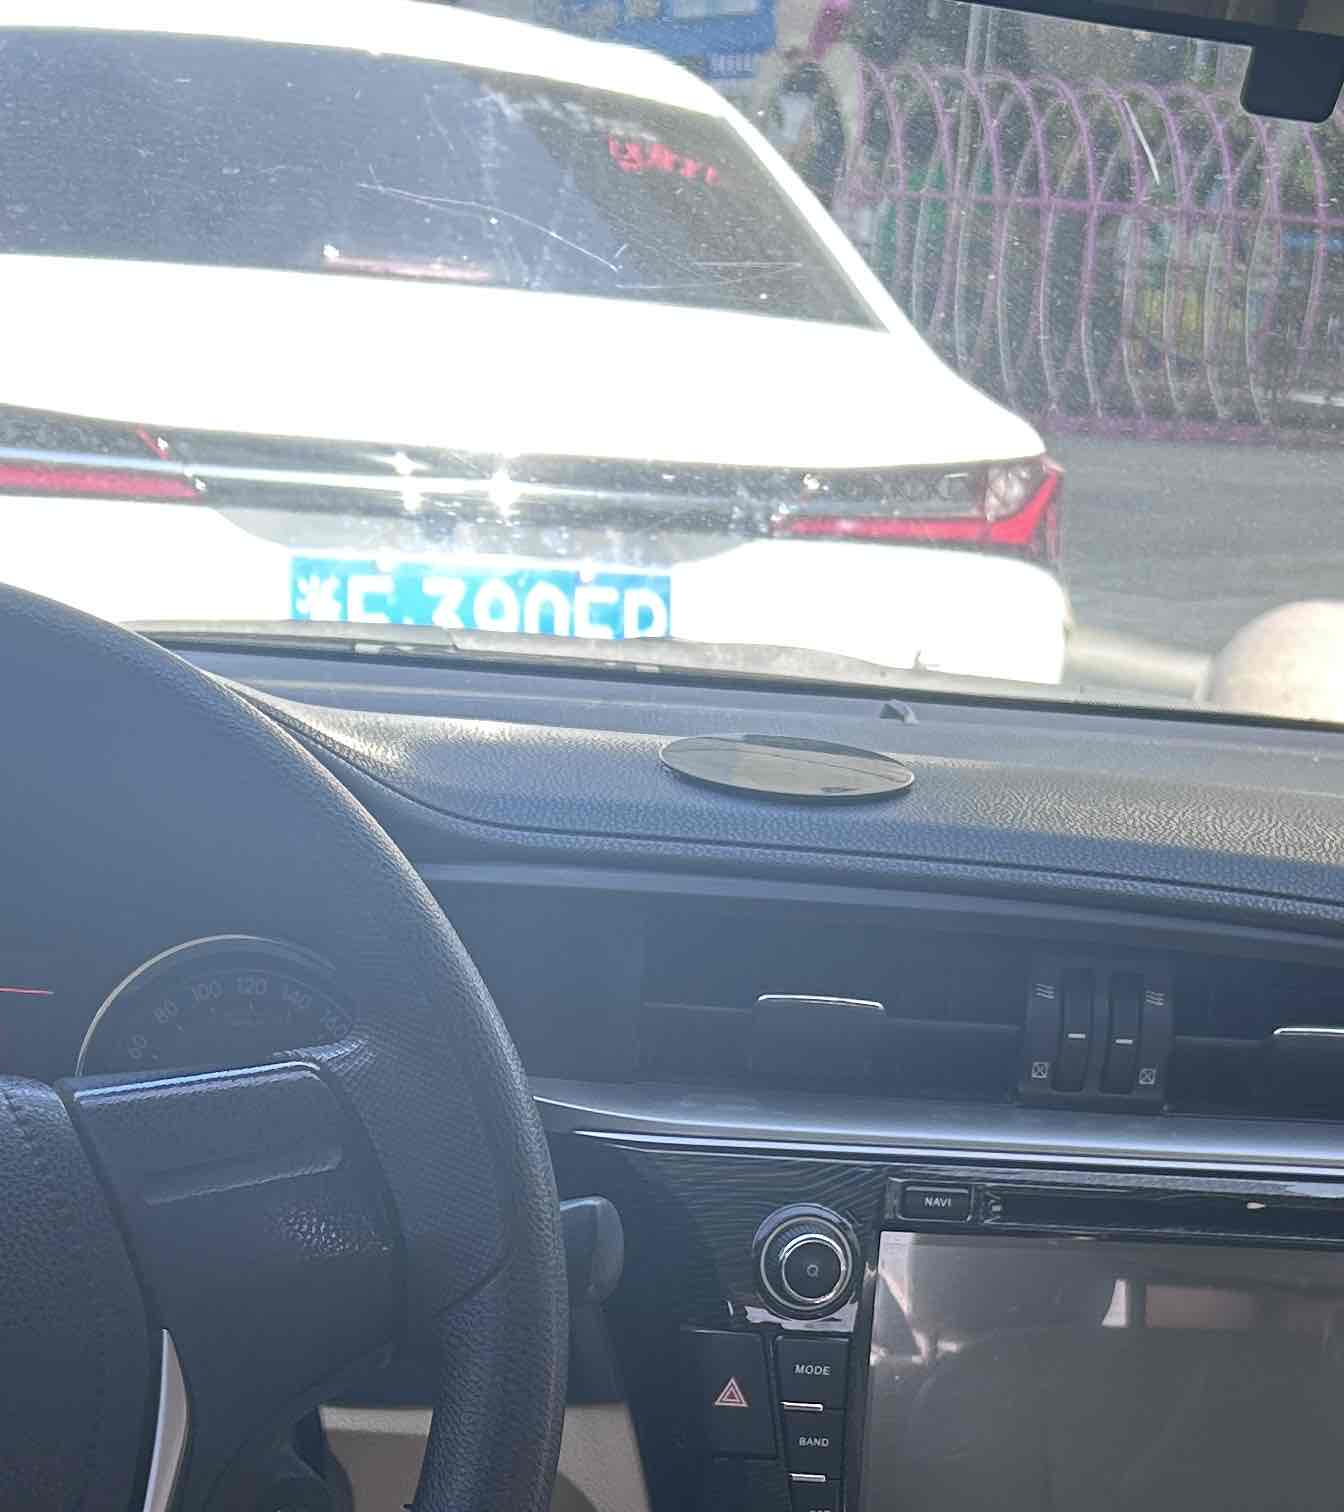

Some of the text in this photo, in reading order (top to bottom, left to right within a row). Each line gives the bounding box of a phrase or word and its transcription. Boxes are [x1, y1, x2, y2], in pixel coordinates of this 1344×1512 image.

[236, 976, 269, 996] 120
[923, 1196, 953, 1208] NAVI
[794, 1364, 832, 1376] MODE
[799, 1436, 830, 1448] BAND
